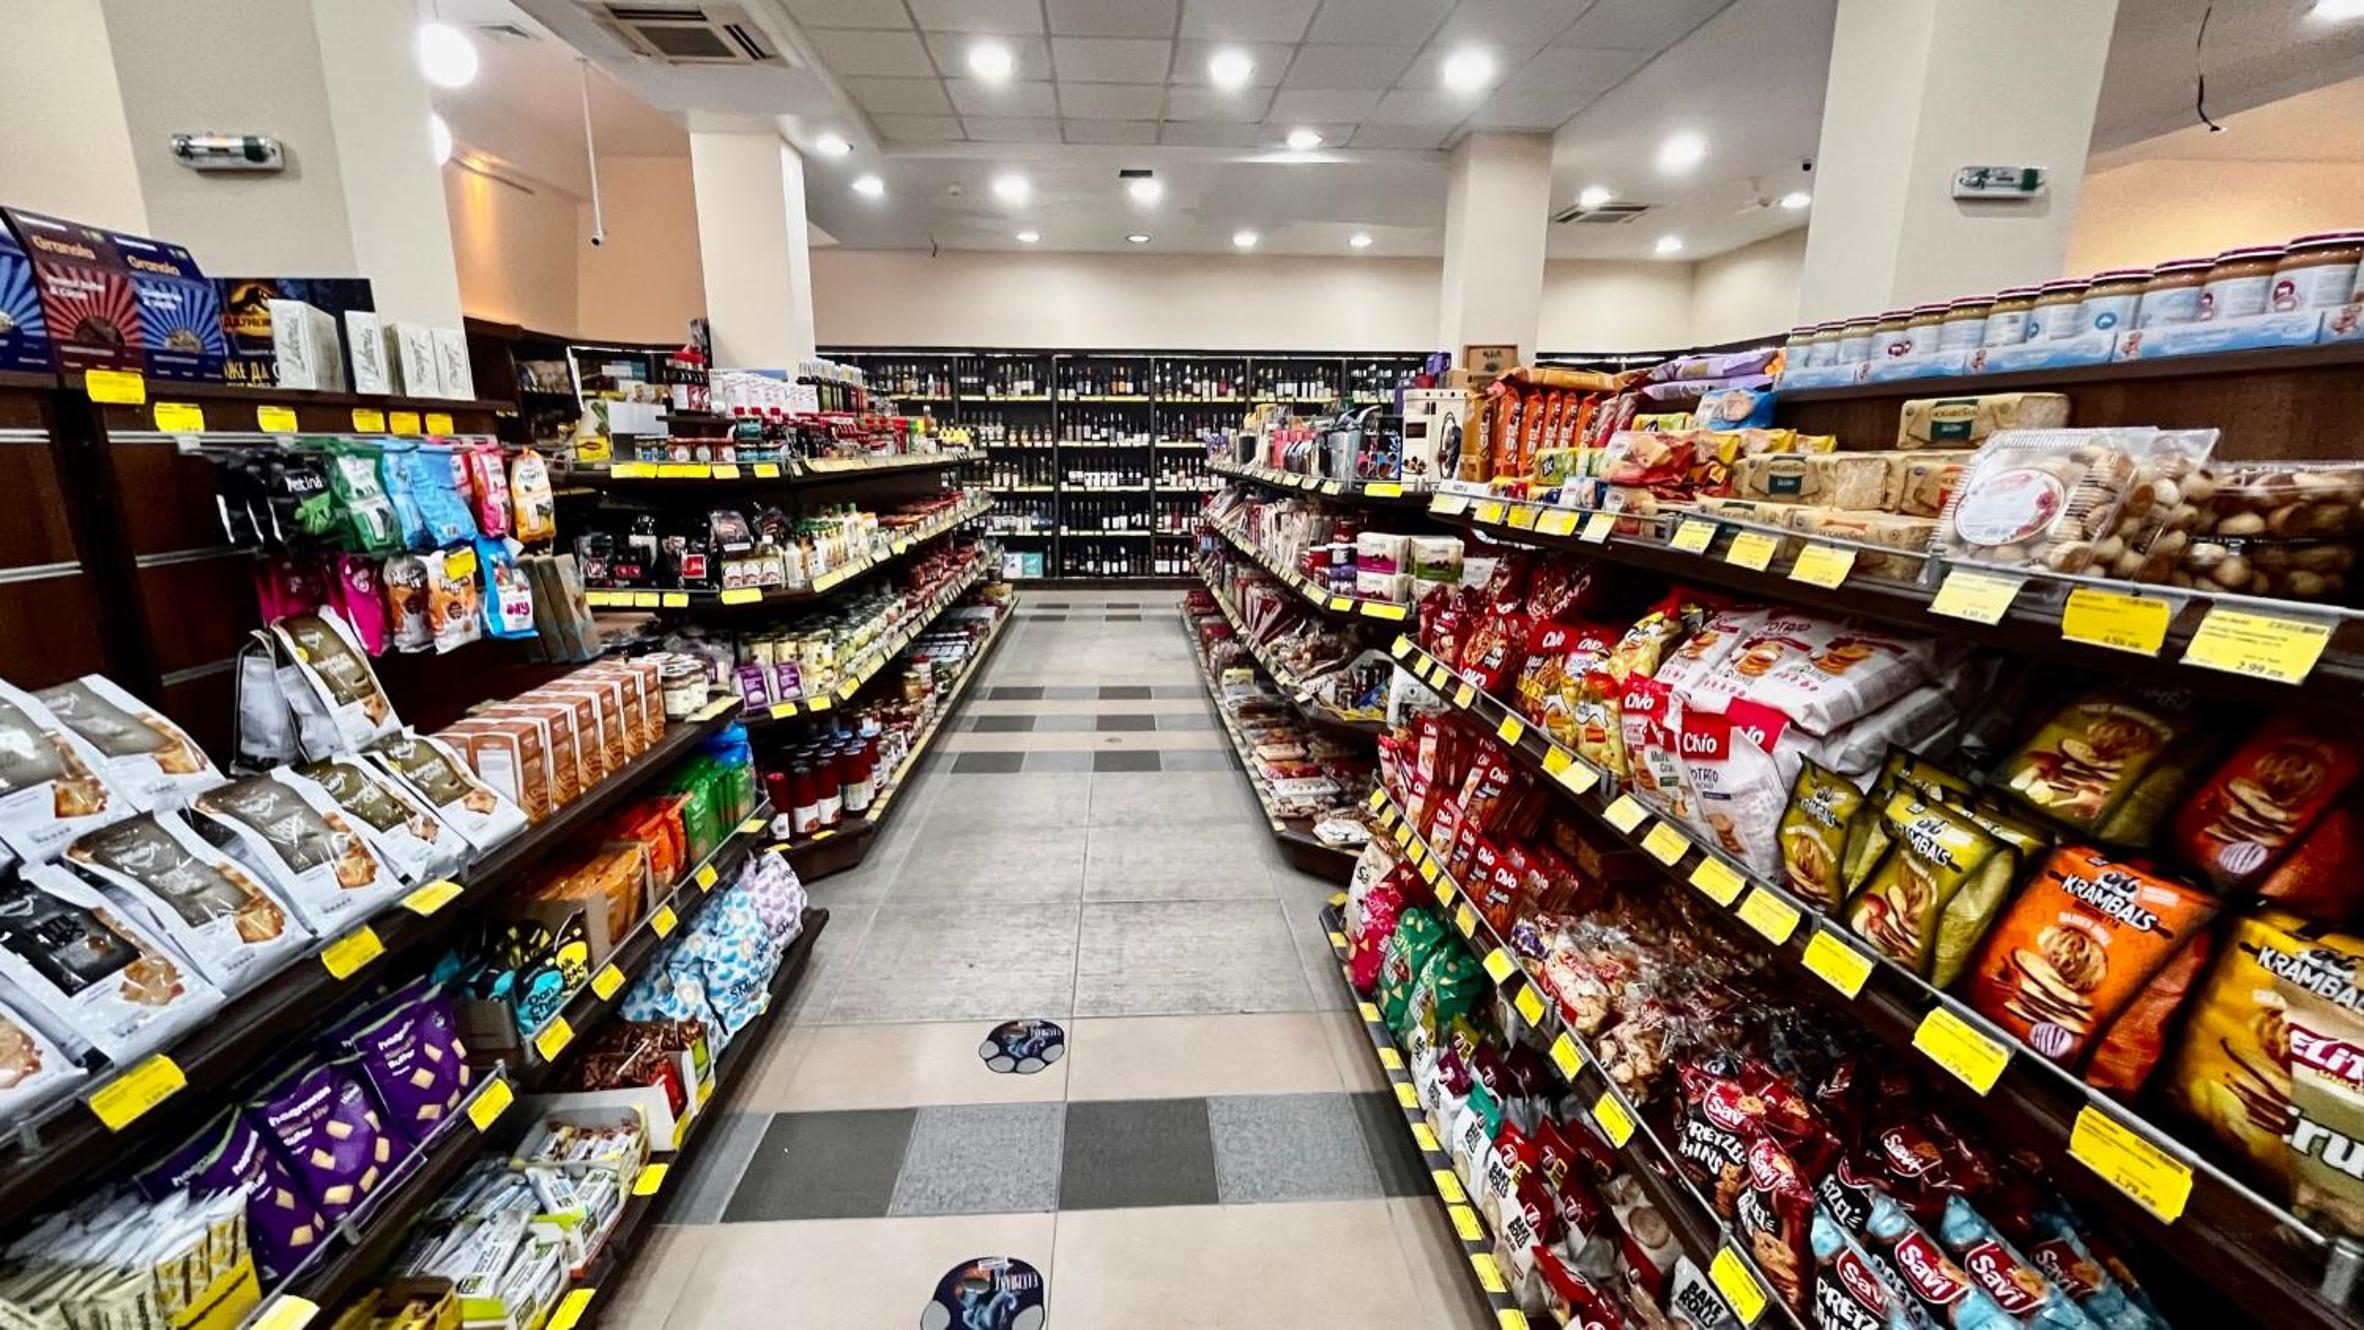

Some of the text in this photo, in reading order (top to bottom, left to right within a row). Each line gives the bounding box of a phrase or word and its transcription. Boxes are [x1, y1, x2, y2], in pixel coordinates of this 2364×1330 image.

[1624, 691, 1655, 710] Chio
[1683, 732, 1717, 753] Chio
[1495, 867, 1517, 889] Chio
[2061, 872, 2157, 932] KRAMBALS
[1708, 1096, 1746, 1125] Sav
[2288, 1110, 2364, 1182] ru
[1845, 1261, 1889, 1306] Sav
[1901, 1244, 1952, 1297] Savi
[1971, 1254, 2027, 1306] Savi
[2035, 1248, 2079, 1292] Savi
[1679, 1289, 1719, 1329] ROLLS
[1688, 1280, 1724, 1315] BAKE
